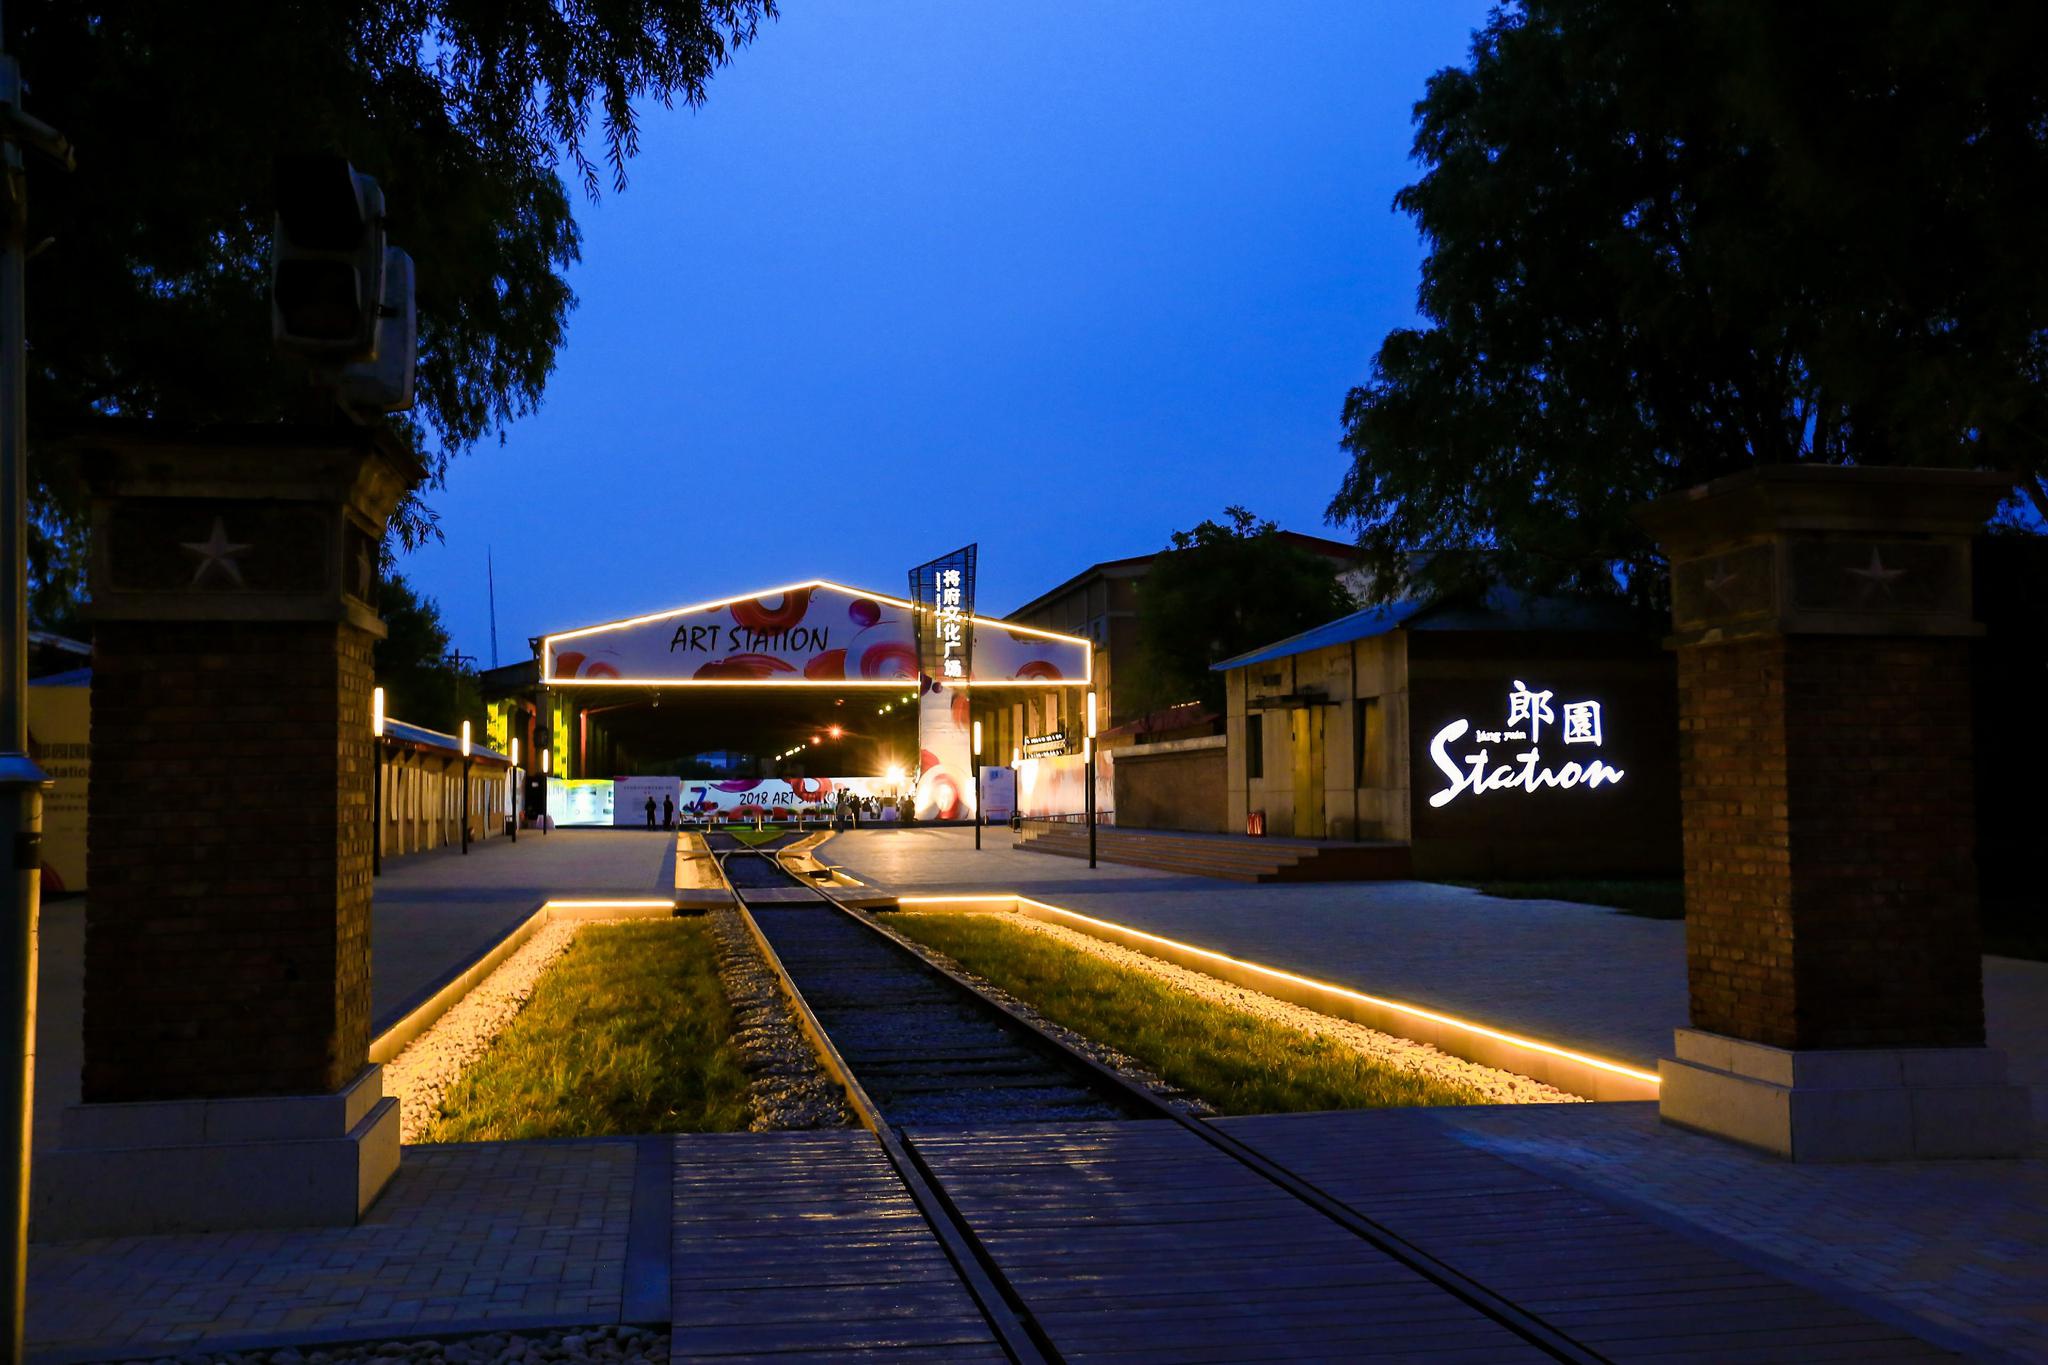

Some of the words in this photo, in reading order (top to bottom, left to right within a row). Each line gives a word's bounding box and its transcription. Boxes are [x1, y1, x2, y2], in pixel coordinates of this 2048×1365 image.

[943, 569, 962, 677] 将府文化广场
[670, 625, 720, 652] ART
[728, 625, 829, 653] STATION
[45, 765, 88, 778] statio
[1429, 718, 1625, 808] Station
[739, 791, 768, 805] 2018
[772, 791, 794, 805] ART
